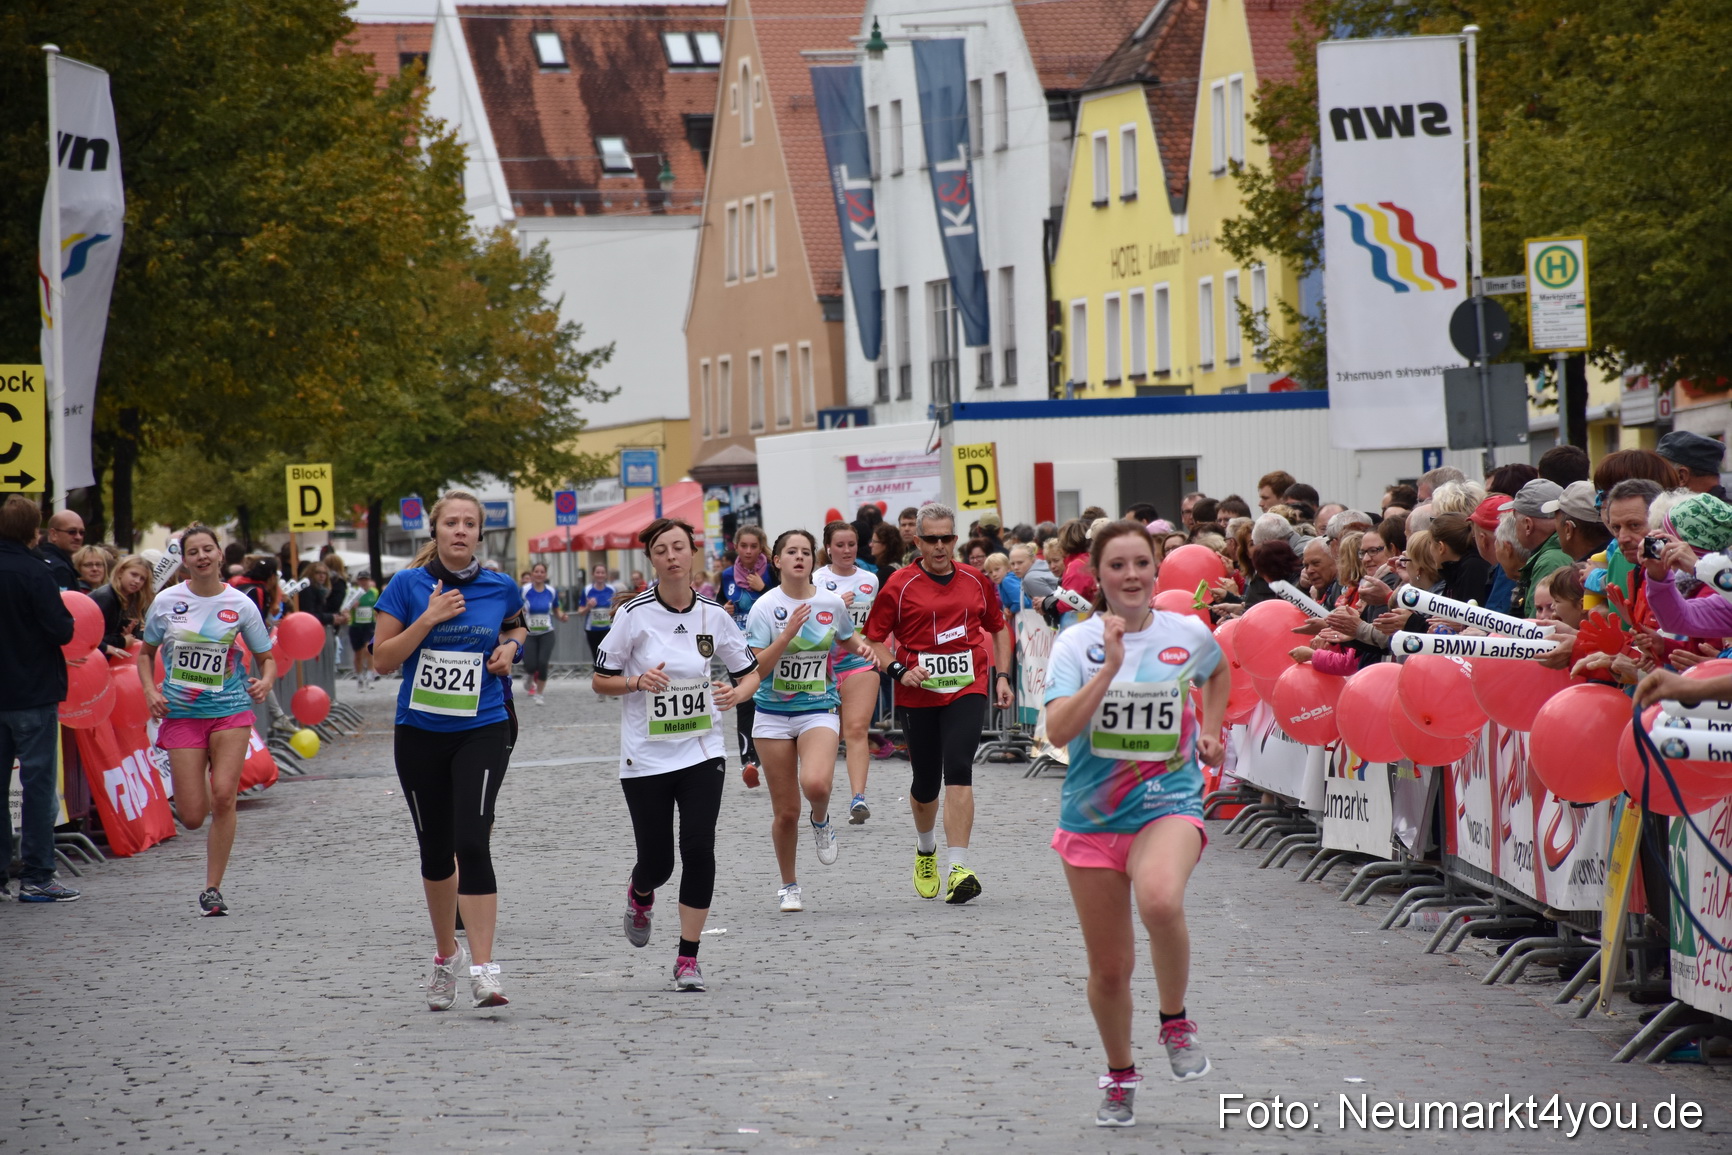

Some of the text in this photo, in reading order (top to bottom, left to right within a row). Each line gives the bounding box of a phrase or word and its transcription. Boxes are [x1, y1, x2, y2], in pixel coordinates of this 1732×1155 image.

[1111, 244, 1142, 280] HOTEL
[957, 446, 993, 460] Block
[292, 467, 327, 480] Block
[965, 463, 989, 496] D
[867, 481, 913, 495] DAHMIT
[300, 485, 322, 517] D
[847, 611, 867, 626] 14
[1428, 596, 1544, 640] bmw-laufsport.de
[1433, 638, 1477, 655] BMW
[178, 651, 222, 673] 5078
[780, 660, 823, 680] 5077
[925, 655, 969, 676] 5065
[181, 672, 214, 684] Elisabeth
[420, 664, 475, 692] 5324
[785, 682, 813, 690] Barbara
[938, 678, 958, 687] Frank
[671, 684, 701, 692] Neumarkt
[1127, 690, 1168, 698] Neumarkt
[654, 691, 706, 718] 5194
[1101, 701, 1174, 730] 5115
[1290, 704, 1333, 724] RÖDL
[664, 720, 697, 732] Melanie
[1122, 738, 1150, 750] Lena
[1145, 780, 1165, 792] 16.
